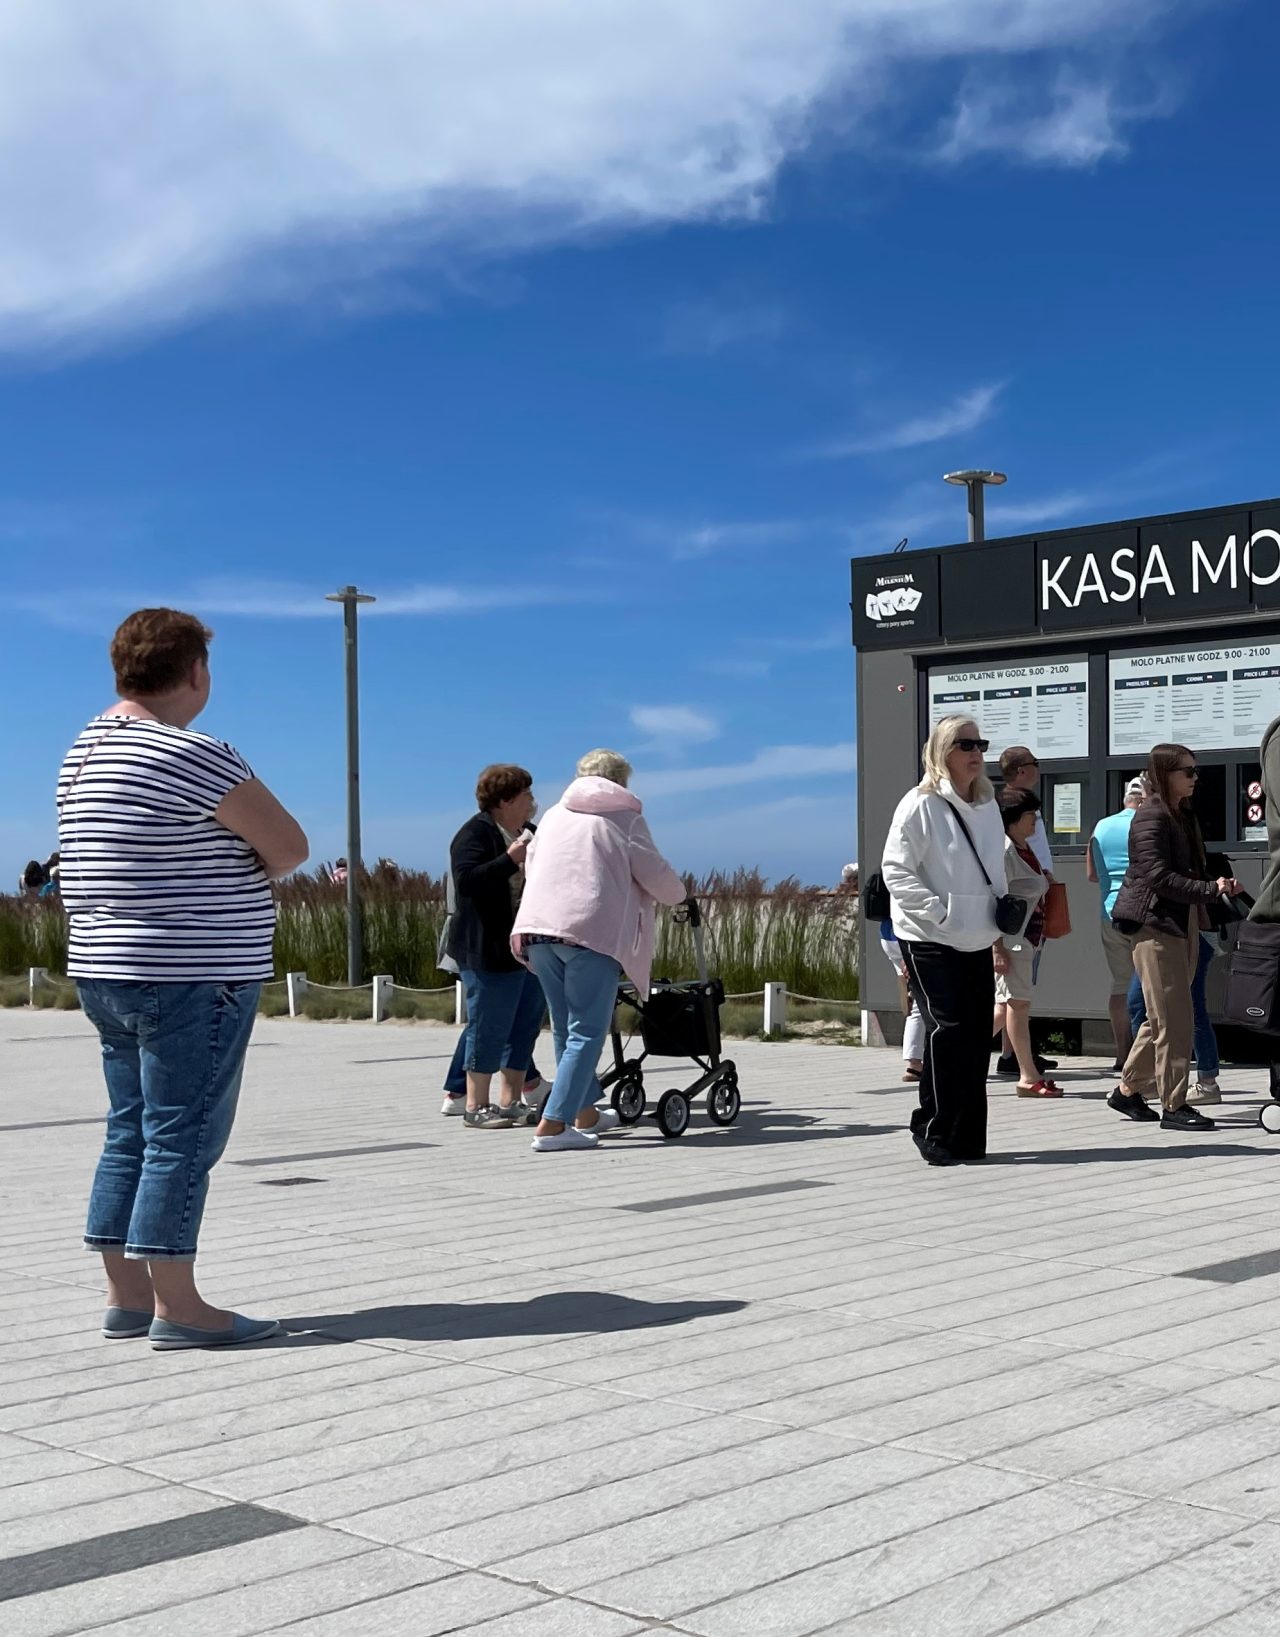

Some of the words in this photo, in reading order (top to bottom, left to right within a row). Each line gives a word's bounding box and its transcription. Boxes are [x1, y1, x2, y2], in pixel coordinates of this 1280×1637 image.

[1042, 544, 1176, 610] KASA
[1131, 658, 1154, 667] MOLO
[1155, 655, 1185, 665] PŁATNE
[1187, 653, 1196, 662] W
[1197, 651, 1222, 661] GODZ.
[1224, 649, 1242, 659] 9.00
[1249, 647, 1271, 657] 21.00
[947, 673, 967, 683] MOLO
[997, 670, 1004, 678] W
[1050, 665, 1069, 674] 21.00
